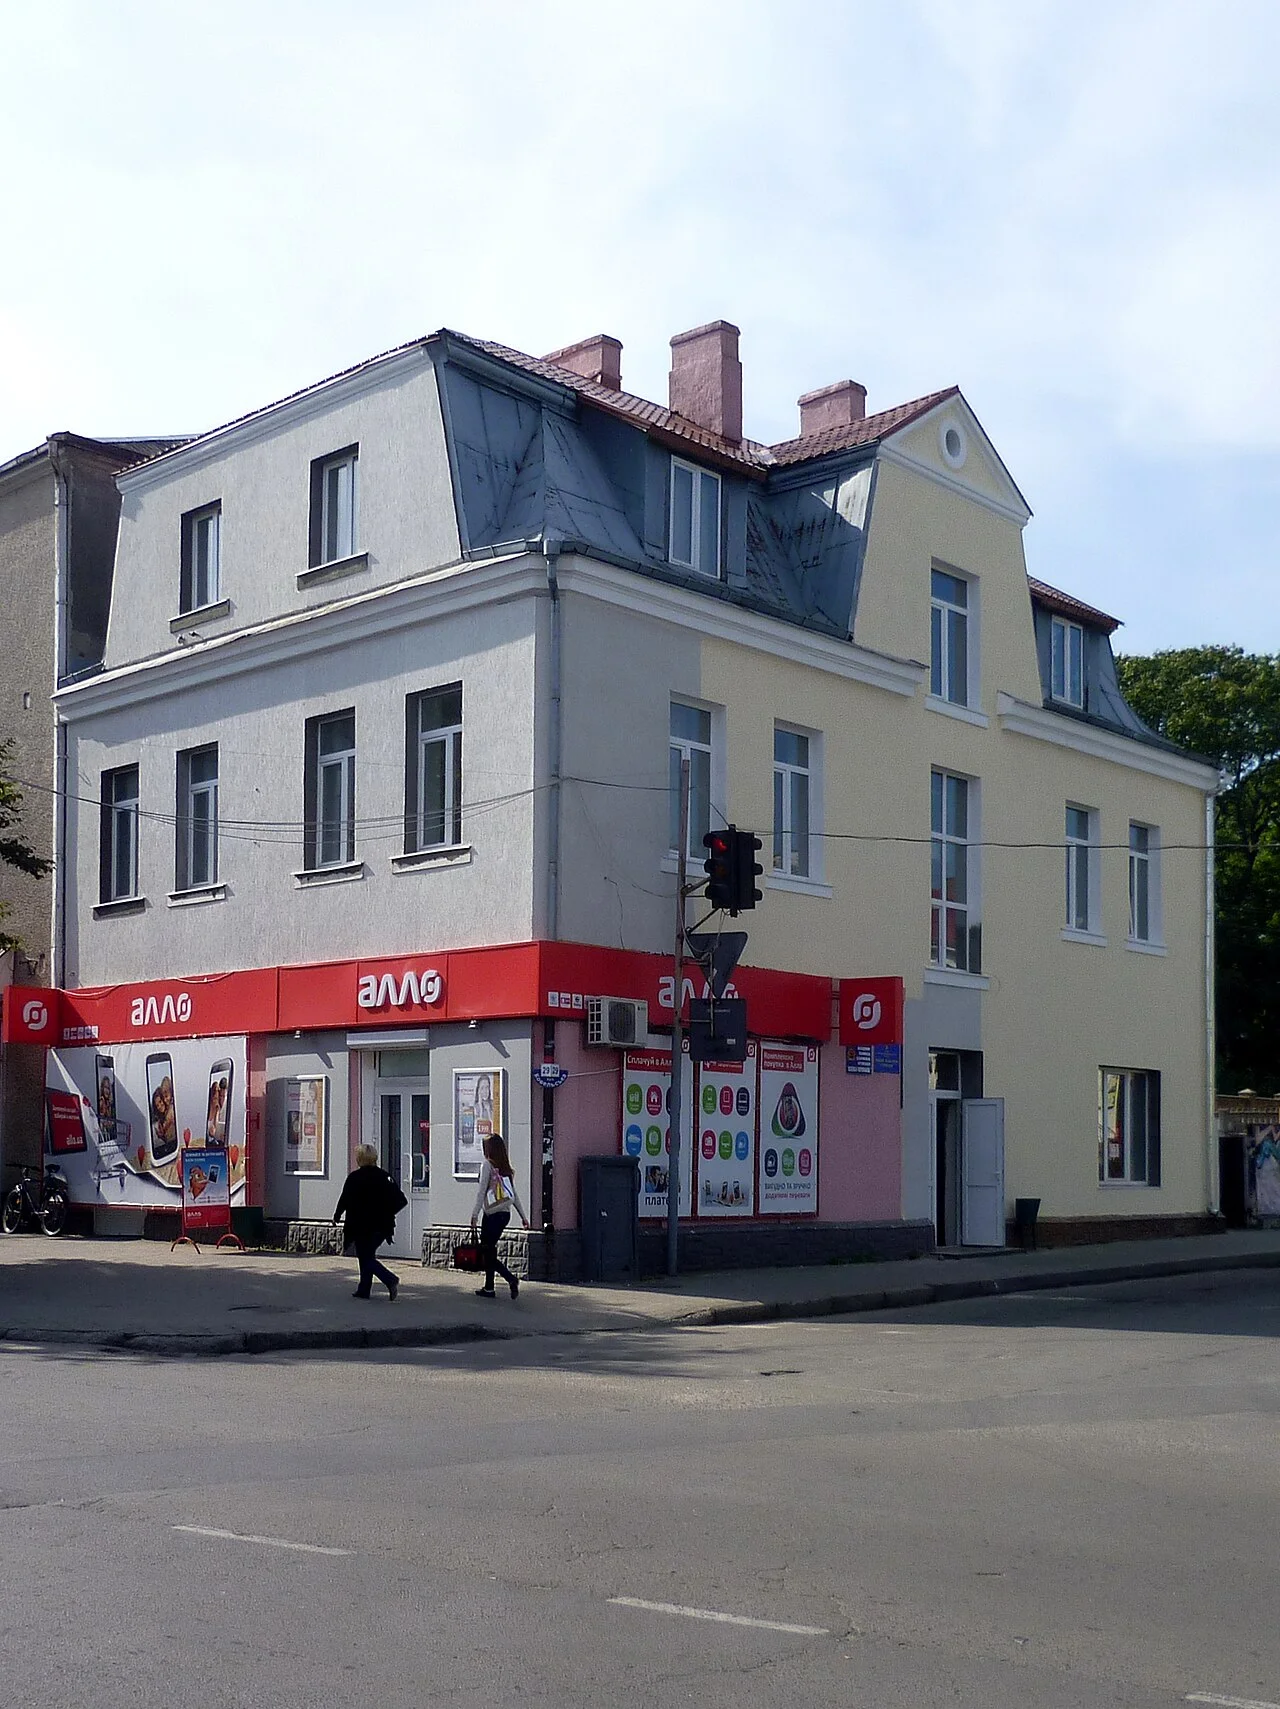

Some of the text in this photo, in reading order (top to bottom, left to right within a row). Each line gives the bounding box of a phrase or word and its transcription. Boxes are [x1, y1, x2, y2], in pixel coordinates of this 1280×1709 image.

[358, 970, 442, 1008] алло
[131, 993, 192, 1026] алло
[627, 1055, 654, 1067] Сплачуй
[660, 1058, 672, 1067] Алл
